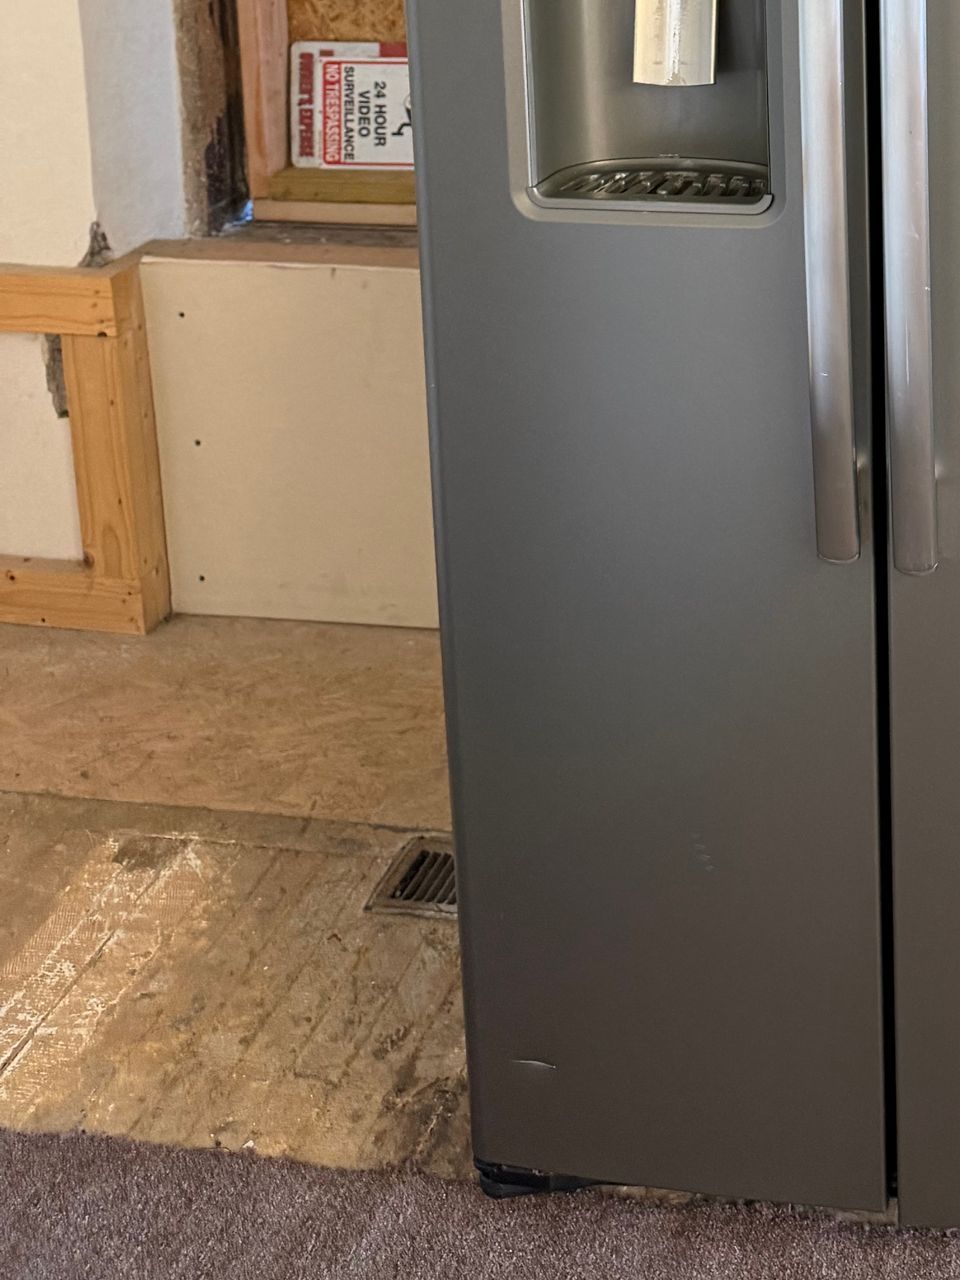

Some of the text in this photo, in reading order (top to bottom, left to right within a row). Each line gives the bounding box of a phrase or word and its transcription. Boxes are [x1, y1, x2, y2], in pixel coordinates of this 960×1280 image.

[325, 63, 340, 162] NO TRESPASSING
[343, 66, 355, 160] SURVEILLANCE
[358, 90, 371, 138] VIDEO
[373, 81, 387, 147] 24 HOUR
